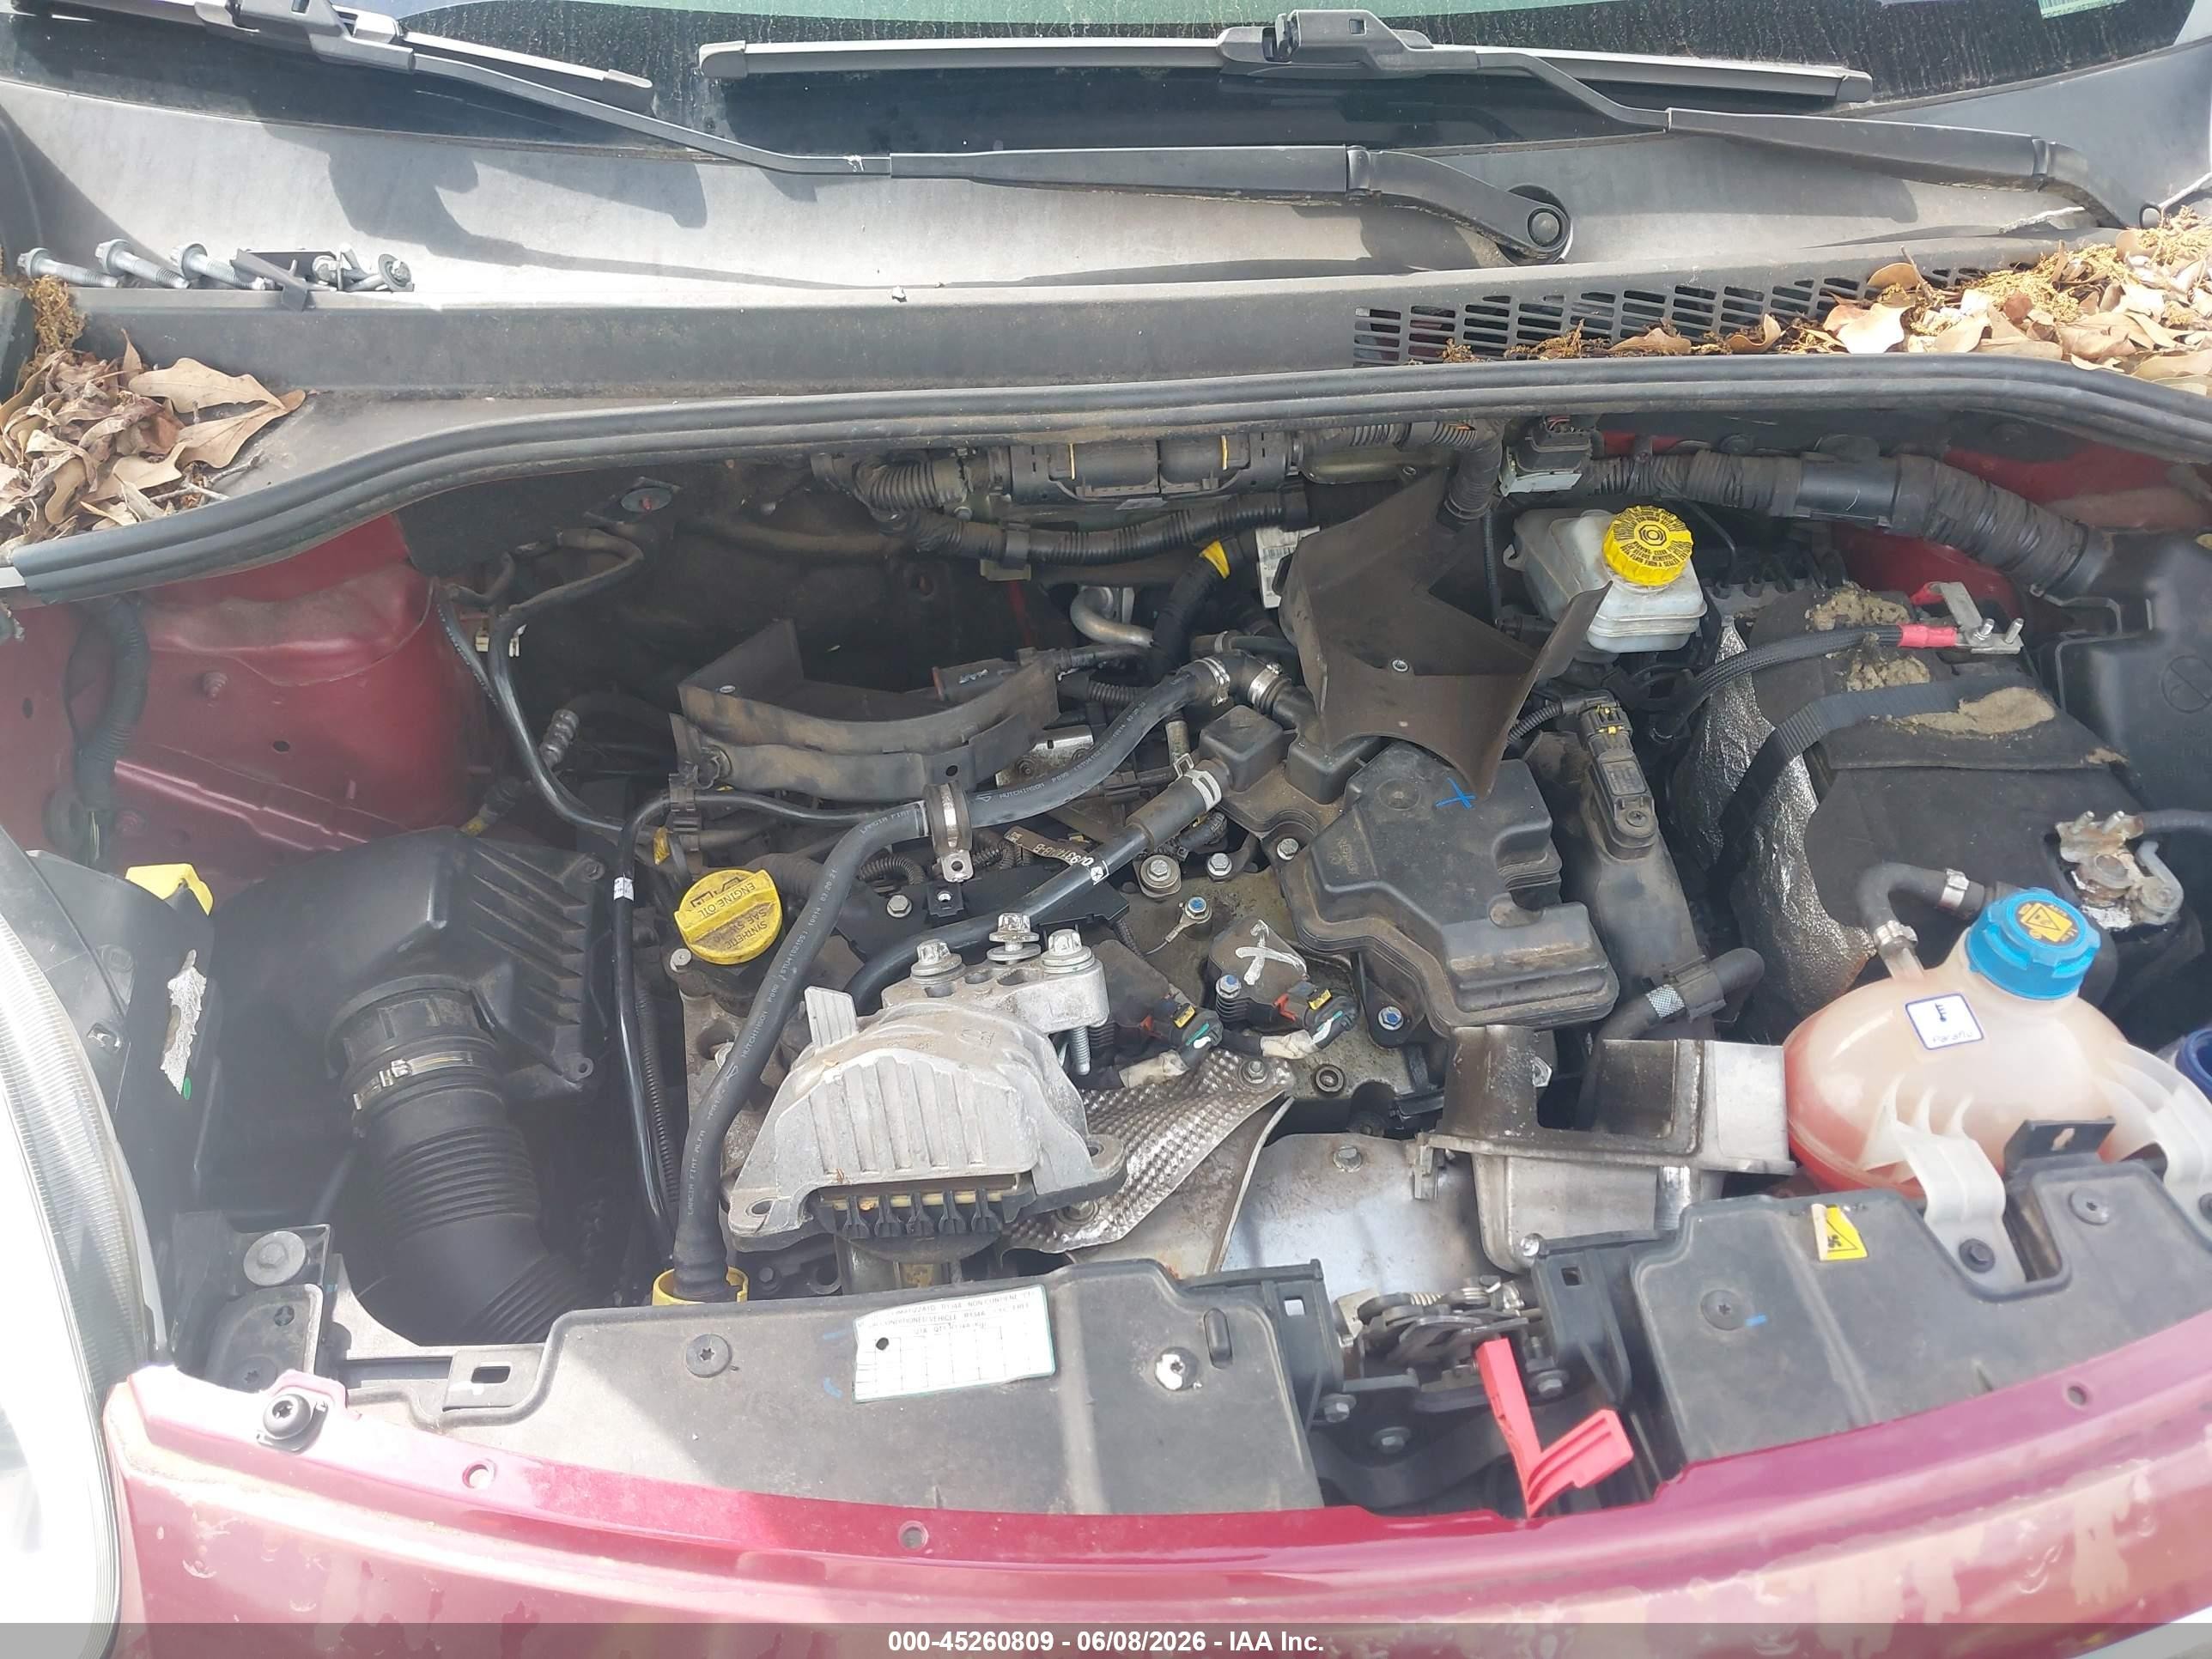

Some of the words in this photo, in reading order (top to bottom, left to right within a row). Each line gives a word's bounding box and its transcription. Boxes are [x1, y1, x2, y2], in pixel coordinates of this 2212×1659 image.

[718, 882, 757, 908] ENGINE
[697, 903, 716, 920] OIL
[747, 908, 767, 925] SAE
[724, 921, 769, 950] SYNTHETIC
[741, 1009, 769, 1059] HUTCHINSON
[689, 1157, 698, 1180] FIAT
[695, 1129, 707, 1153] ALFA
